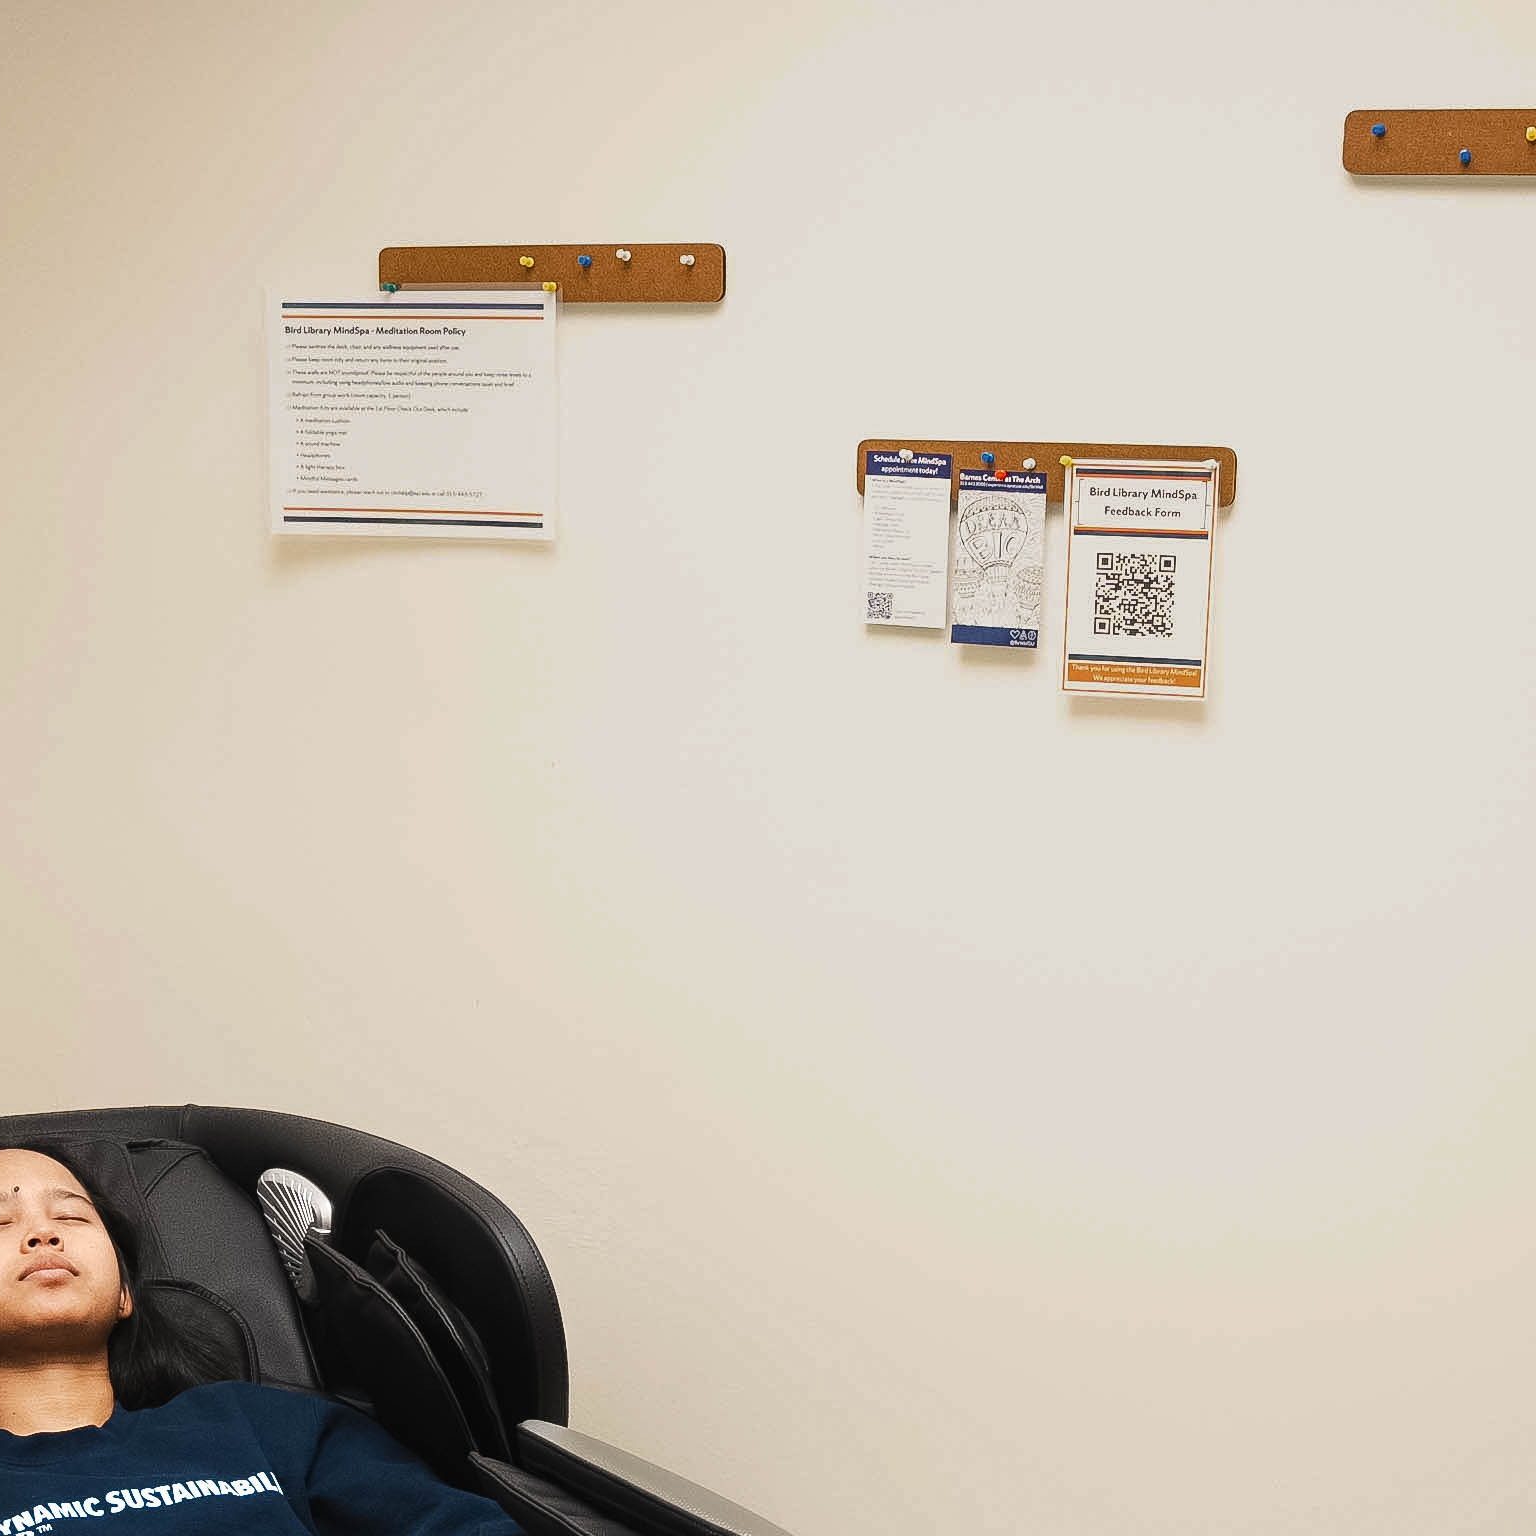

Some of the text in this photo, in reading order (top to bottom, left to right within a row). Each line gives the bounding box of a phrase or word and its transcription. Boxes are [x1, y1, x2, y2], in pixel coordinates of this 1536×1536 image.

[285, 326, 302, 334] Bird
[304, 326, 332, 336] Library
[333, 326, 370, 336] MindSpa
[376, 326, 418, 335] Meditation
[419, 327, 442, 335] Room
[443, 327, 466, 336] Policy
[873, 454, 901, 464] Schedule
[917, 456, 947, 467] MindSpa
[881, 466, 939, 475] appointment today!
[960, 472, 982, 481] Barnes
[1012, 475, 1024, 484] The
[1024, 476, 1041, 484] Arch
[1089, 486, 1198, 501] Bird Library MindSpa
[1104, 505, 1181, 518] Feedback Form
[1111, 666, 1125, 674] using
[1136, 666, 1150, 674] Bird
[1150, 667, 1170, 676] Library
[1093, 673, 1103, 681] We
[1103, 675, 1134, 683] appreciate
